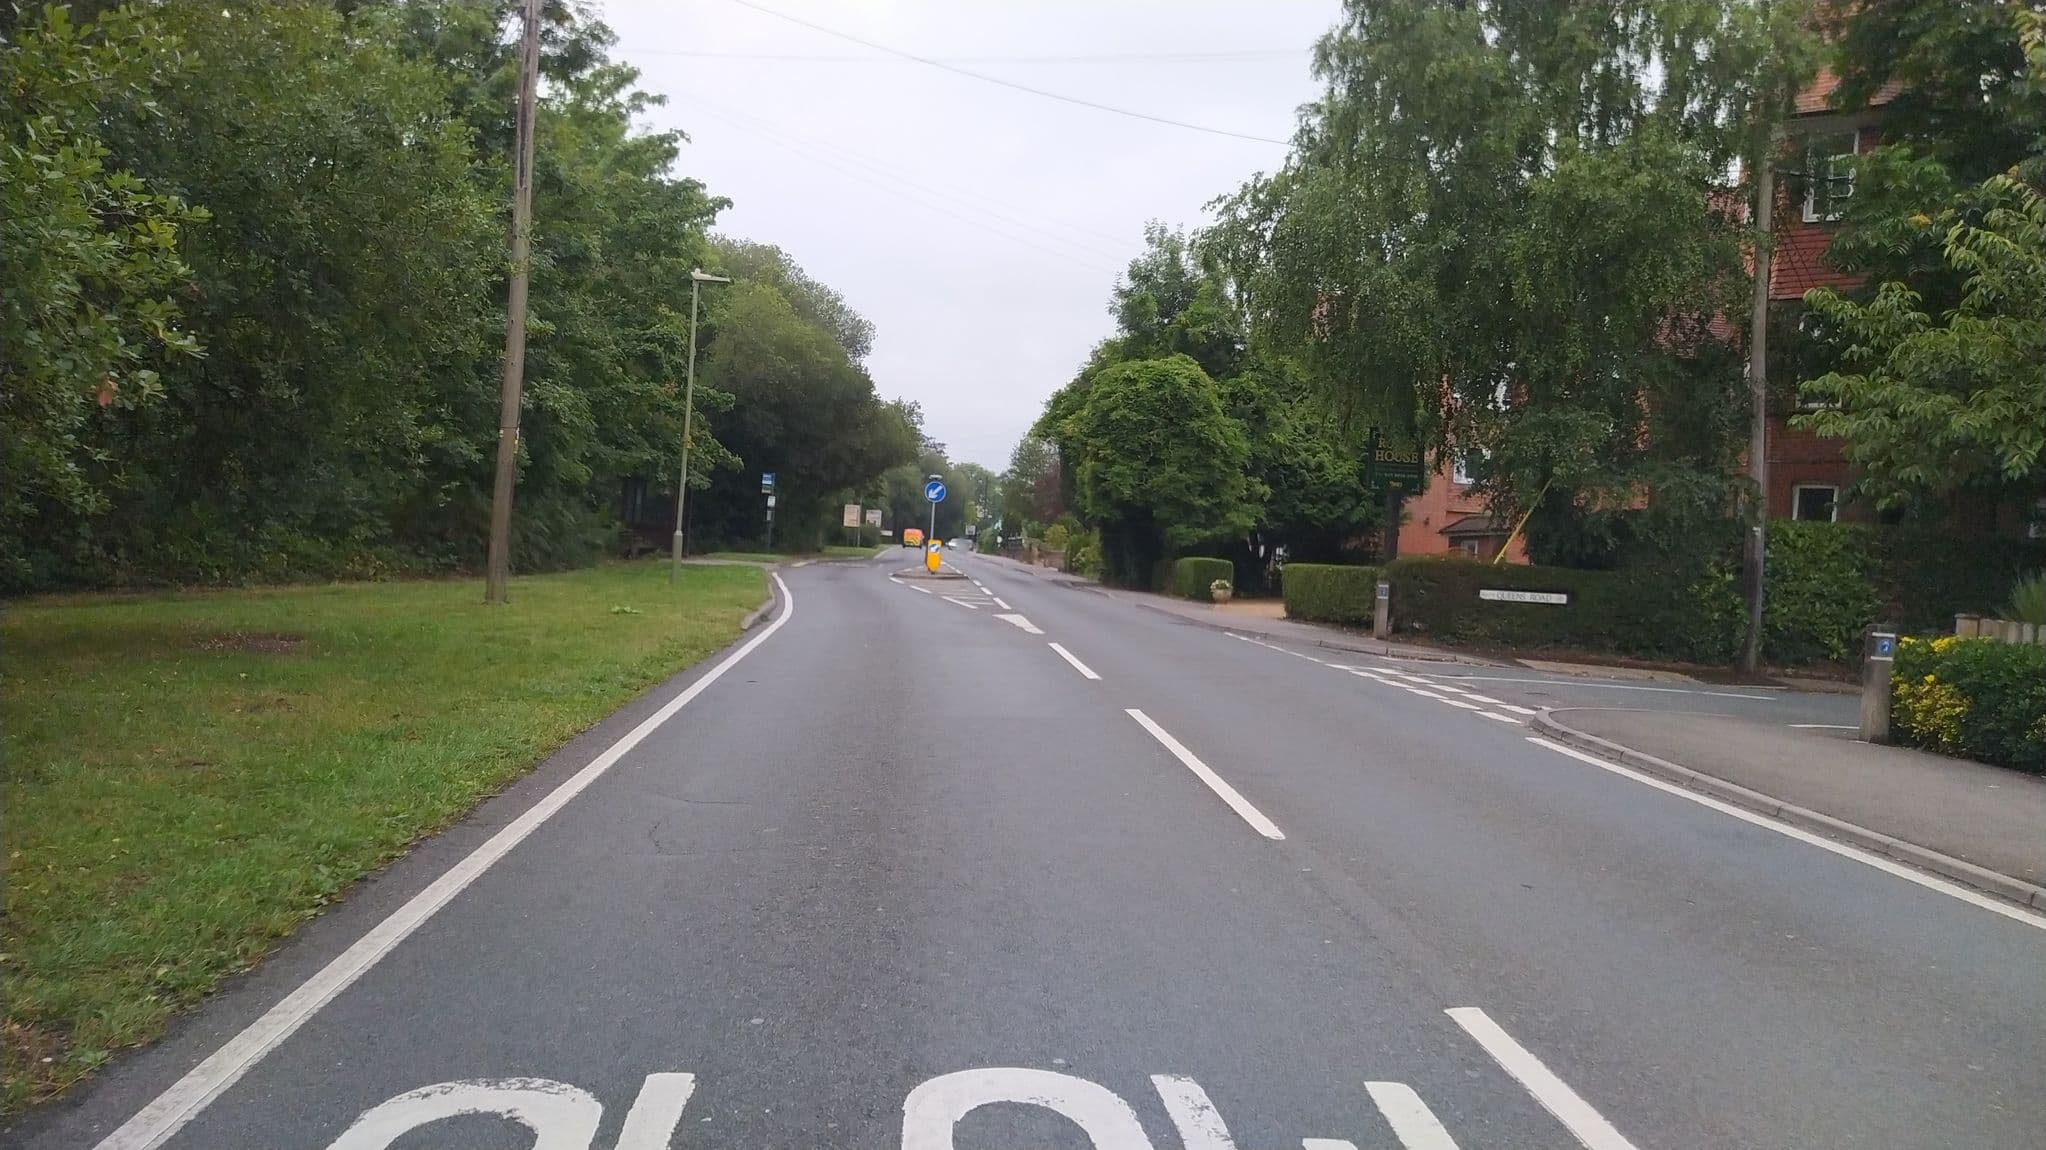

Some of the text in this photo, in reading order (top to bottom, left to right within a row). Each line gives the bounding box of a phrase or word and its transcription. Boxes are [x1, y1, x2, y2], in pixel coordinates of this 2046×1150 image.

[1375, 449, 1419, 464] HOUSE
[1496, 591, 1527, 601] QUEENS
[1529, 593, 1552, 602] ROAD
